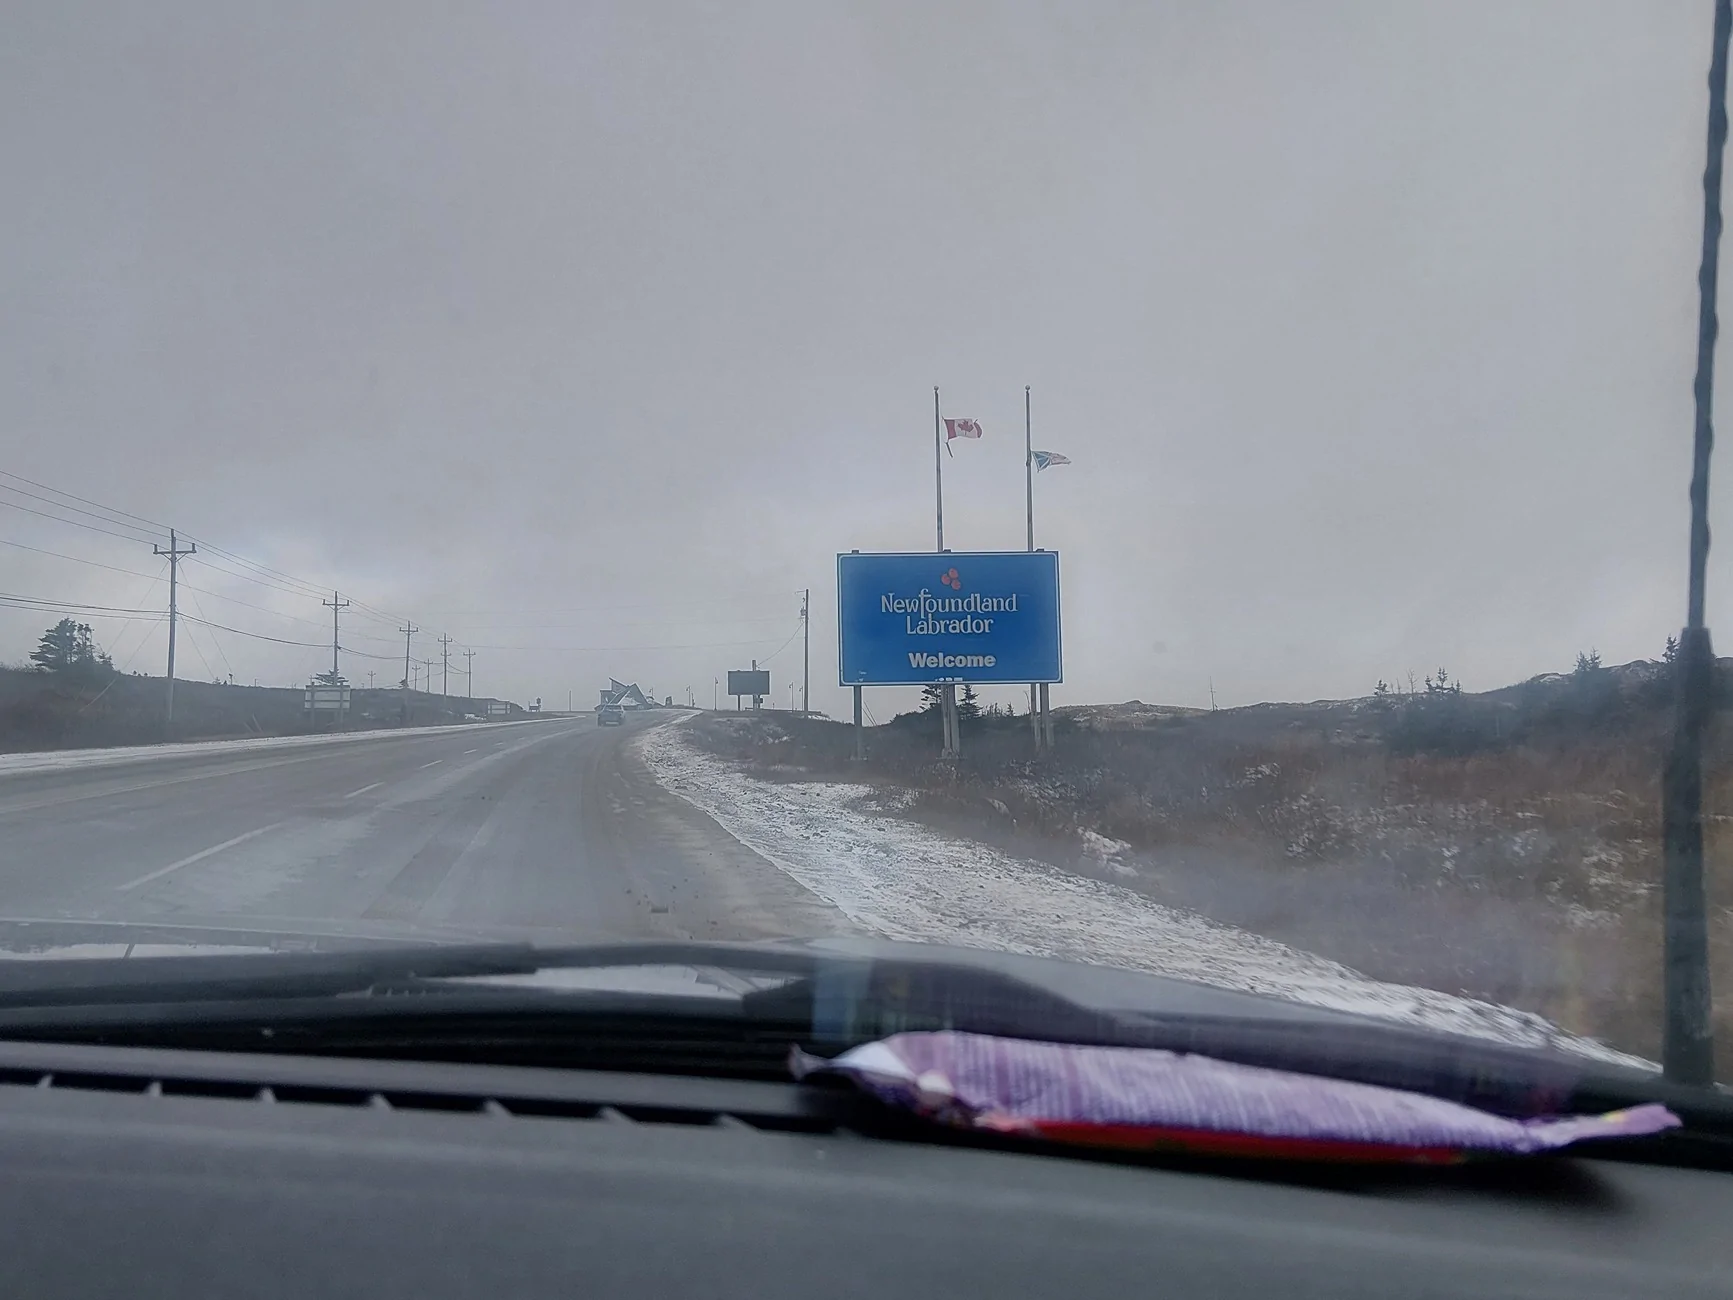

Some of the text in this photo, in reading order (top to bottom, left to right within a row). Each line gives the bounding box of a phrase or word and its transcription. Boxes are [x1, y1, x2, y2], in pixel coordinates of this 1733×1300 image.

[881, 588, 1018, 618] Newfoundland
[906, 613, 994, 635] Labrador
[908, 652, 996, 668] Welcome
